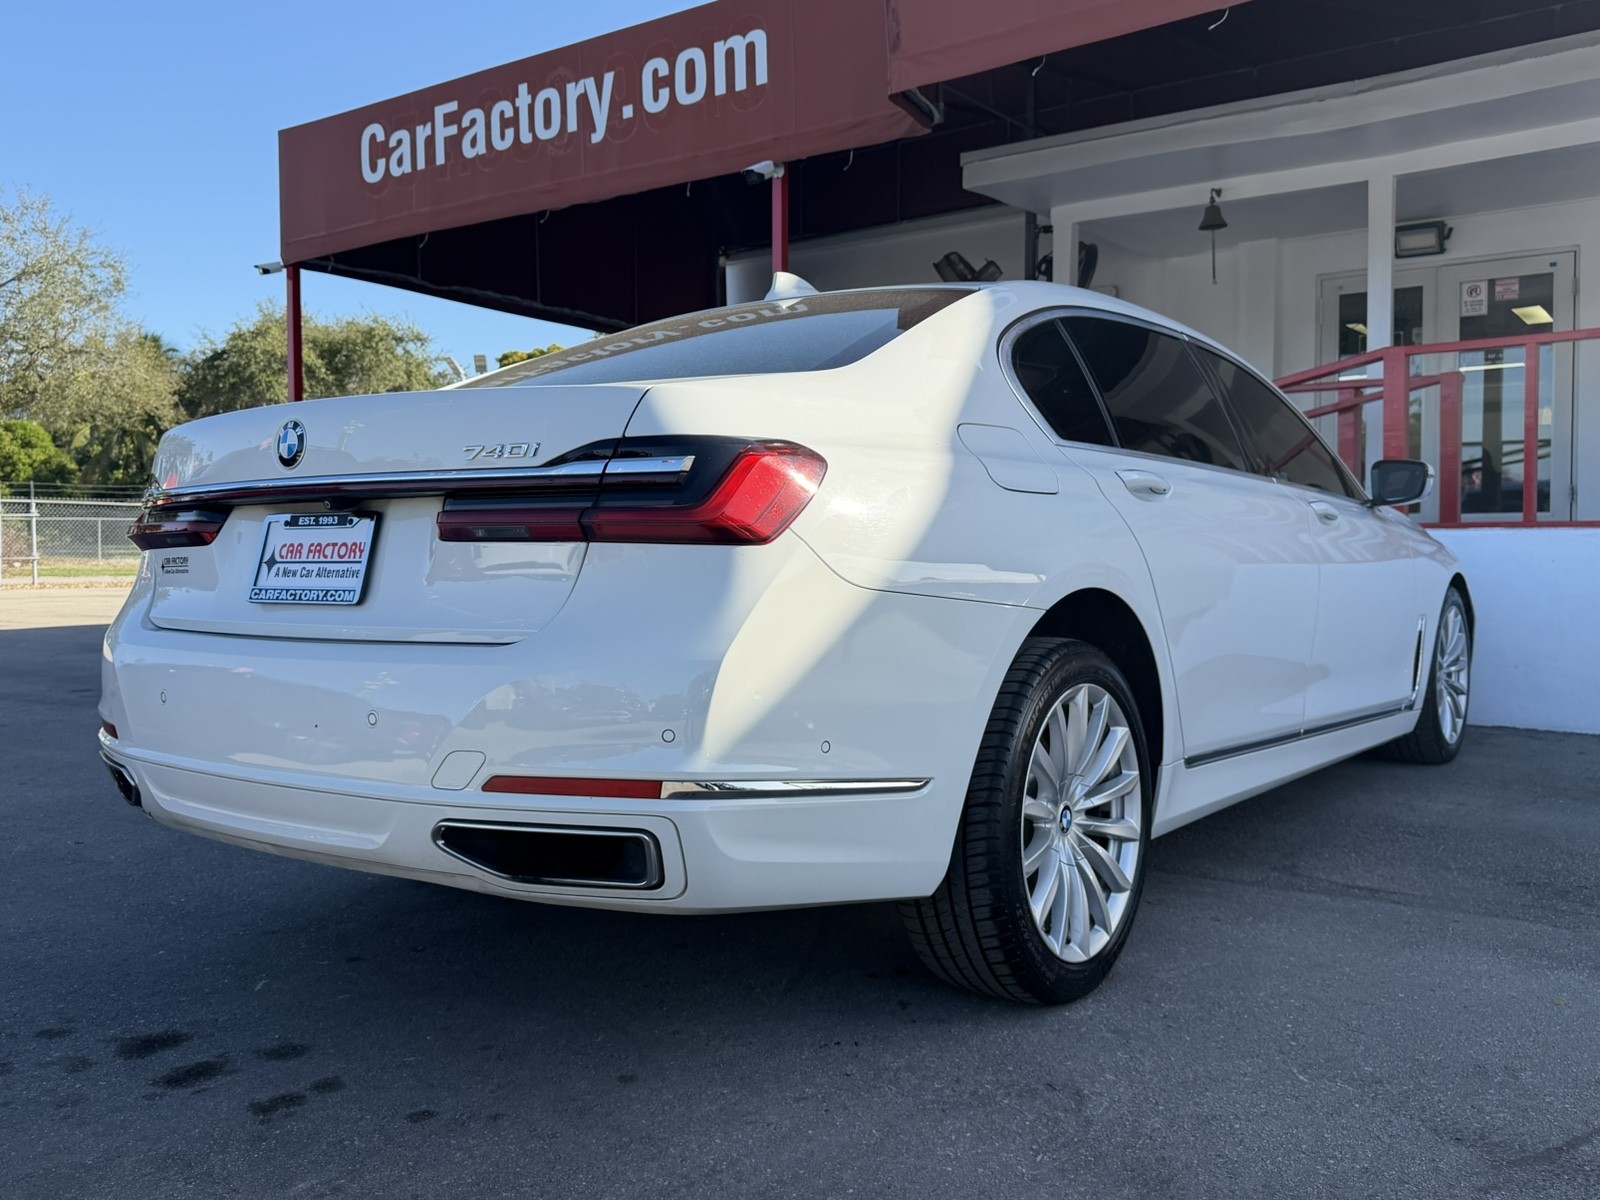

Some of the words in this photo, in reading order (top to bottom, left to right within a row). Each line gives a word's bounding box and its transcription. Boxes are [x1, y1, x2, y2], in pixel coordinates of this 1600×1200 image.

[360, 28, 769, 184] CarFactory.com
[463, 442, 541, 461] 740i
[298, 516, 316, 526] EST.
[318, 515, 339, 525] 1993
[278, 542, 304, 560] CAR
[306, 541, 367, 560] FACTORY
[274, 566, 281, 579] A
[281, 566, 299, 579] New
[299, 566, 315, 579] Car
[315, 566, 361, 579] Alternative
[250, 589, 355, 601] CARFACTORY.COM
